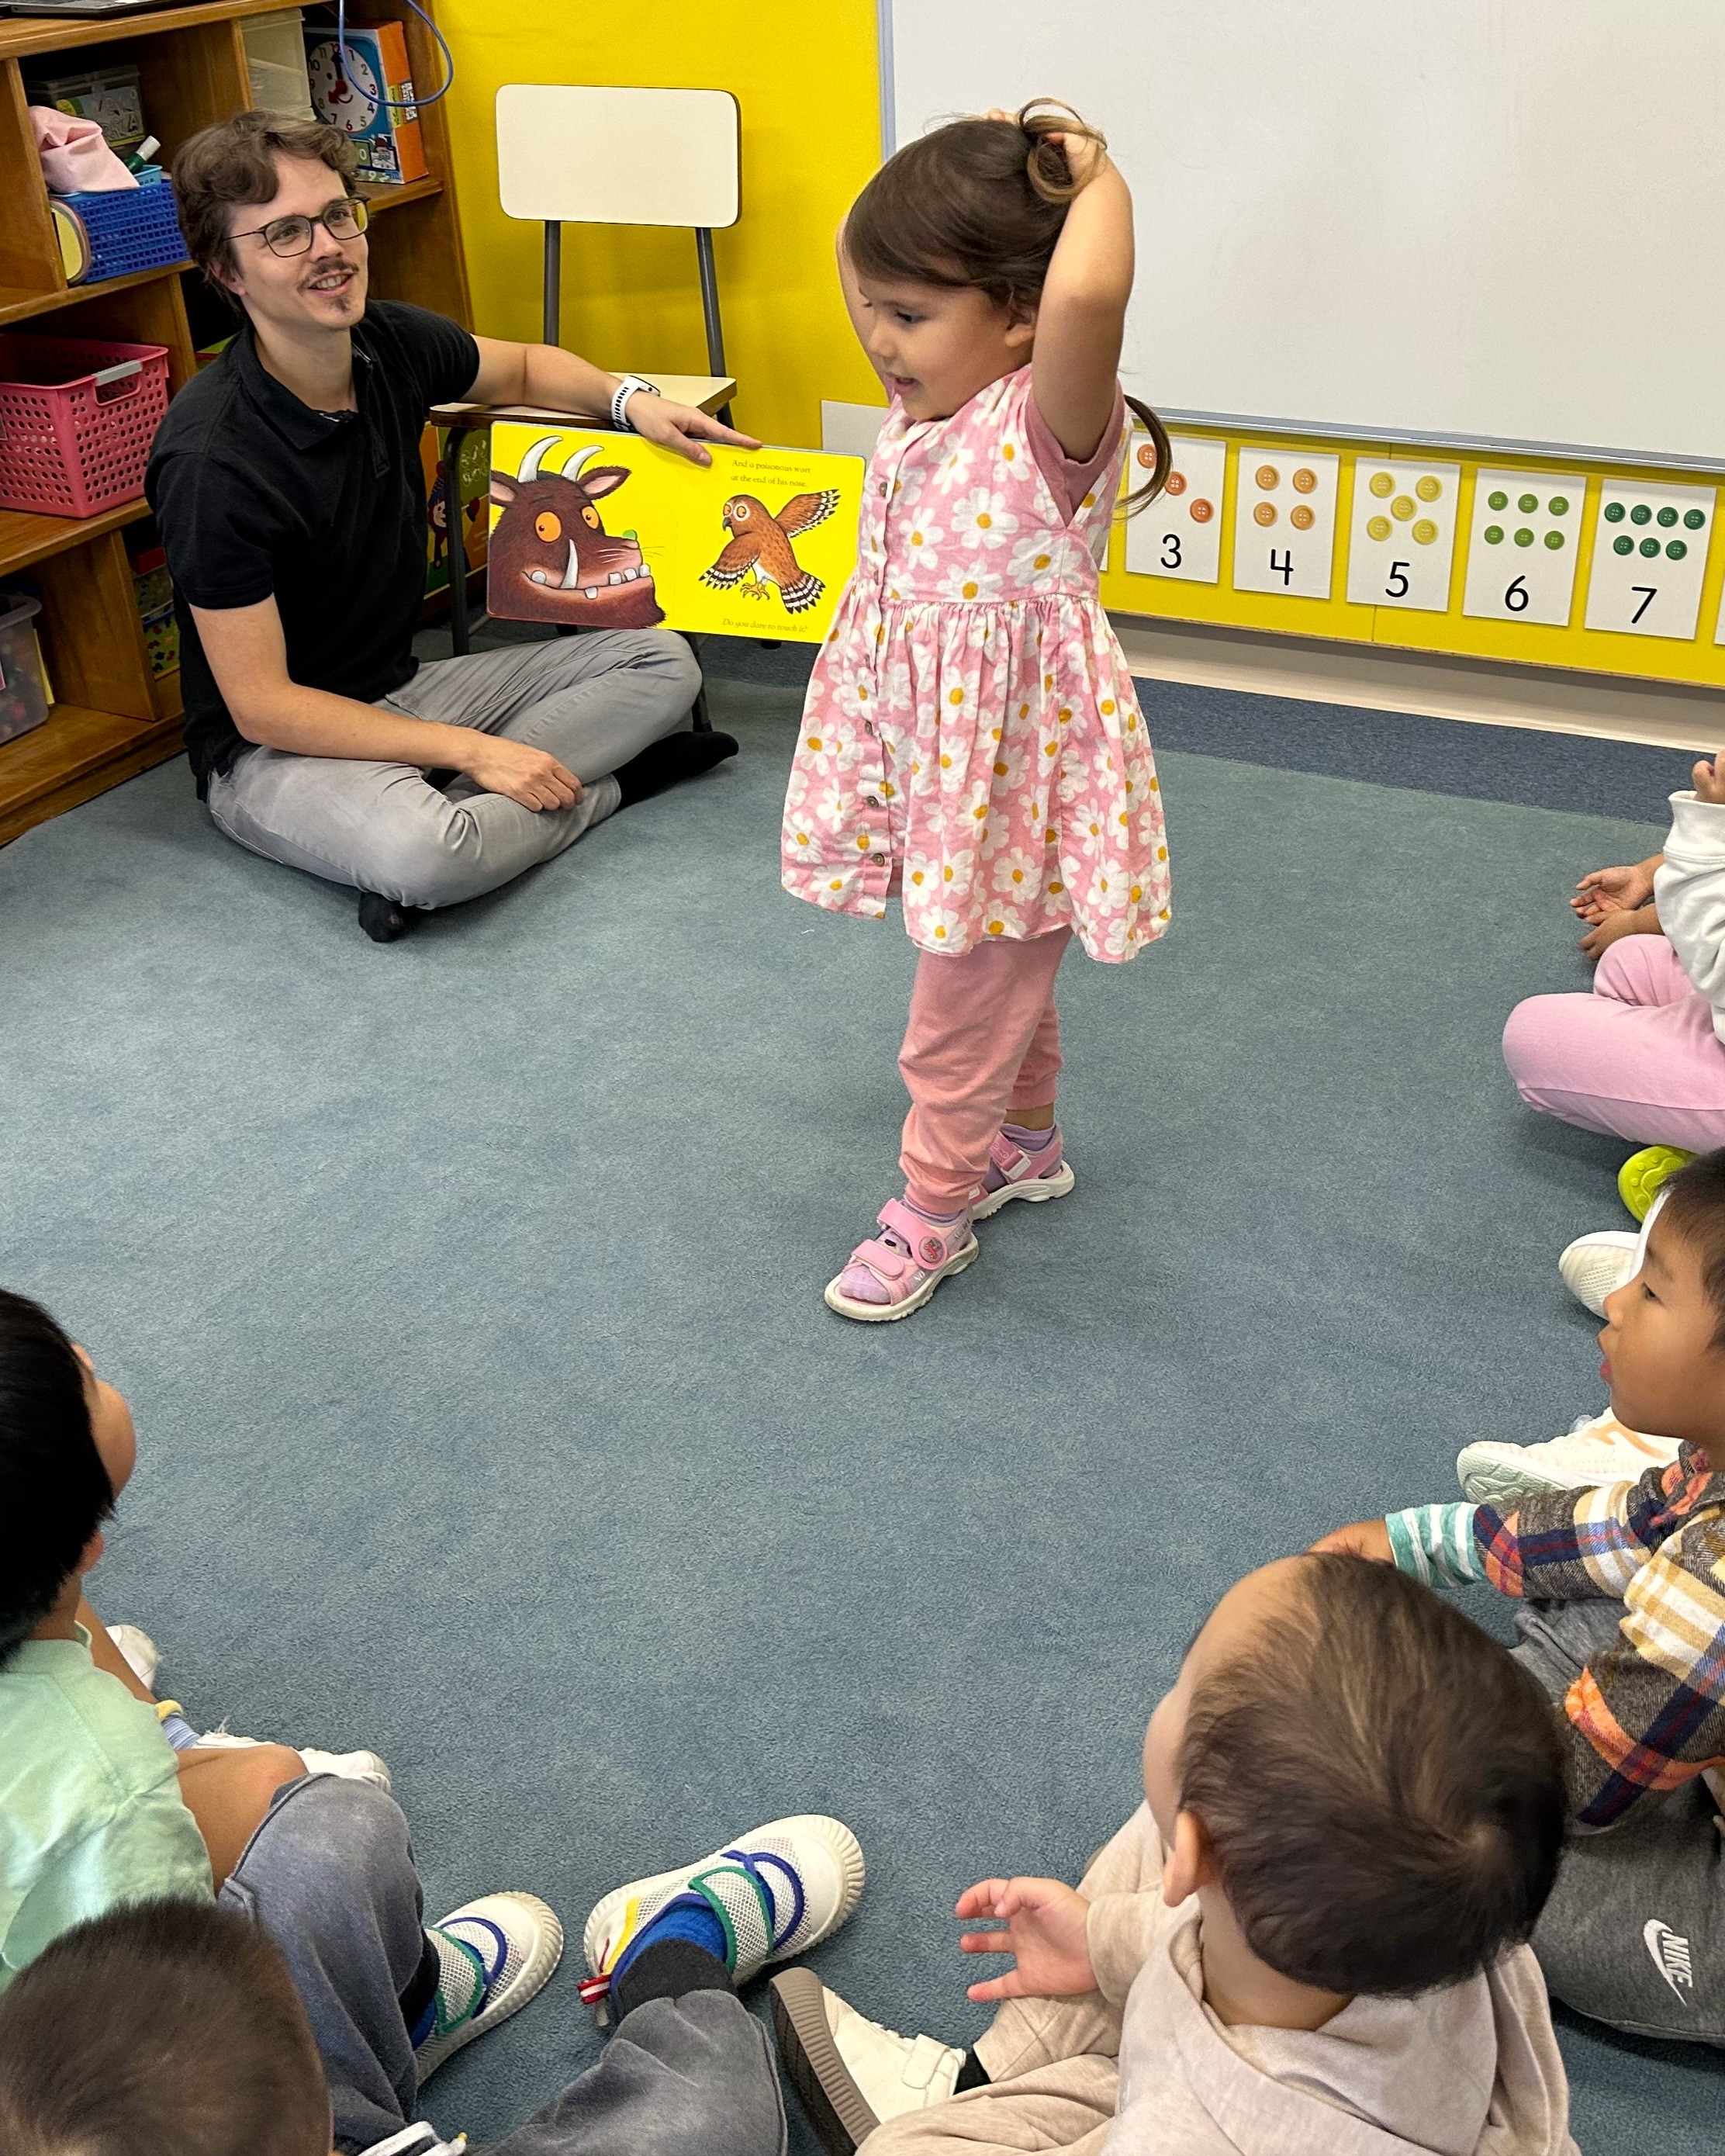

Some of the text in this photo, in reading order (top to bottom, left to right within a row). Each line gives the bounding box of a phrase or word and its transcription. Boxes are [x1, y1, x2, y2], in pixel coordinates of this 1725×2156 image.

[349, 50, 354, 61] 1
[310, 60, 320, 71] 10
[361, 64, 368, 75] 2
[309, 78, 315, 89] 9
[370, 84, 376, 95] 3
[318, 99, 325, 109] 8
[368, 104, 375, 113] 4
[331, 113, 337, 124] 7
[360, 116, 367, 127] 5
[346, 120, 352, 130] 6
[1160, 534, 1181, 569] 3
[1269, 549, 1294, 586] 4
[1385, 562, 1410, 597] 5
[1505, 576, 1529, 612] 6
[1630, 587, 1657, 624] 7
[750, 621, 766, 629] dare
[1661, 1931, 1692, 1987] NIKE
